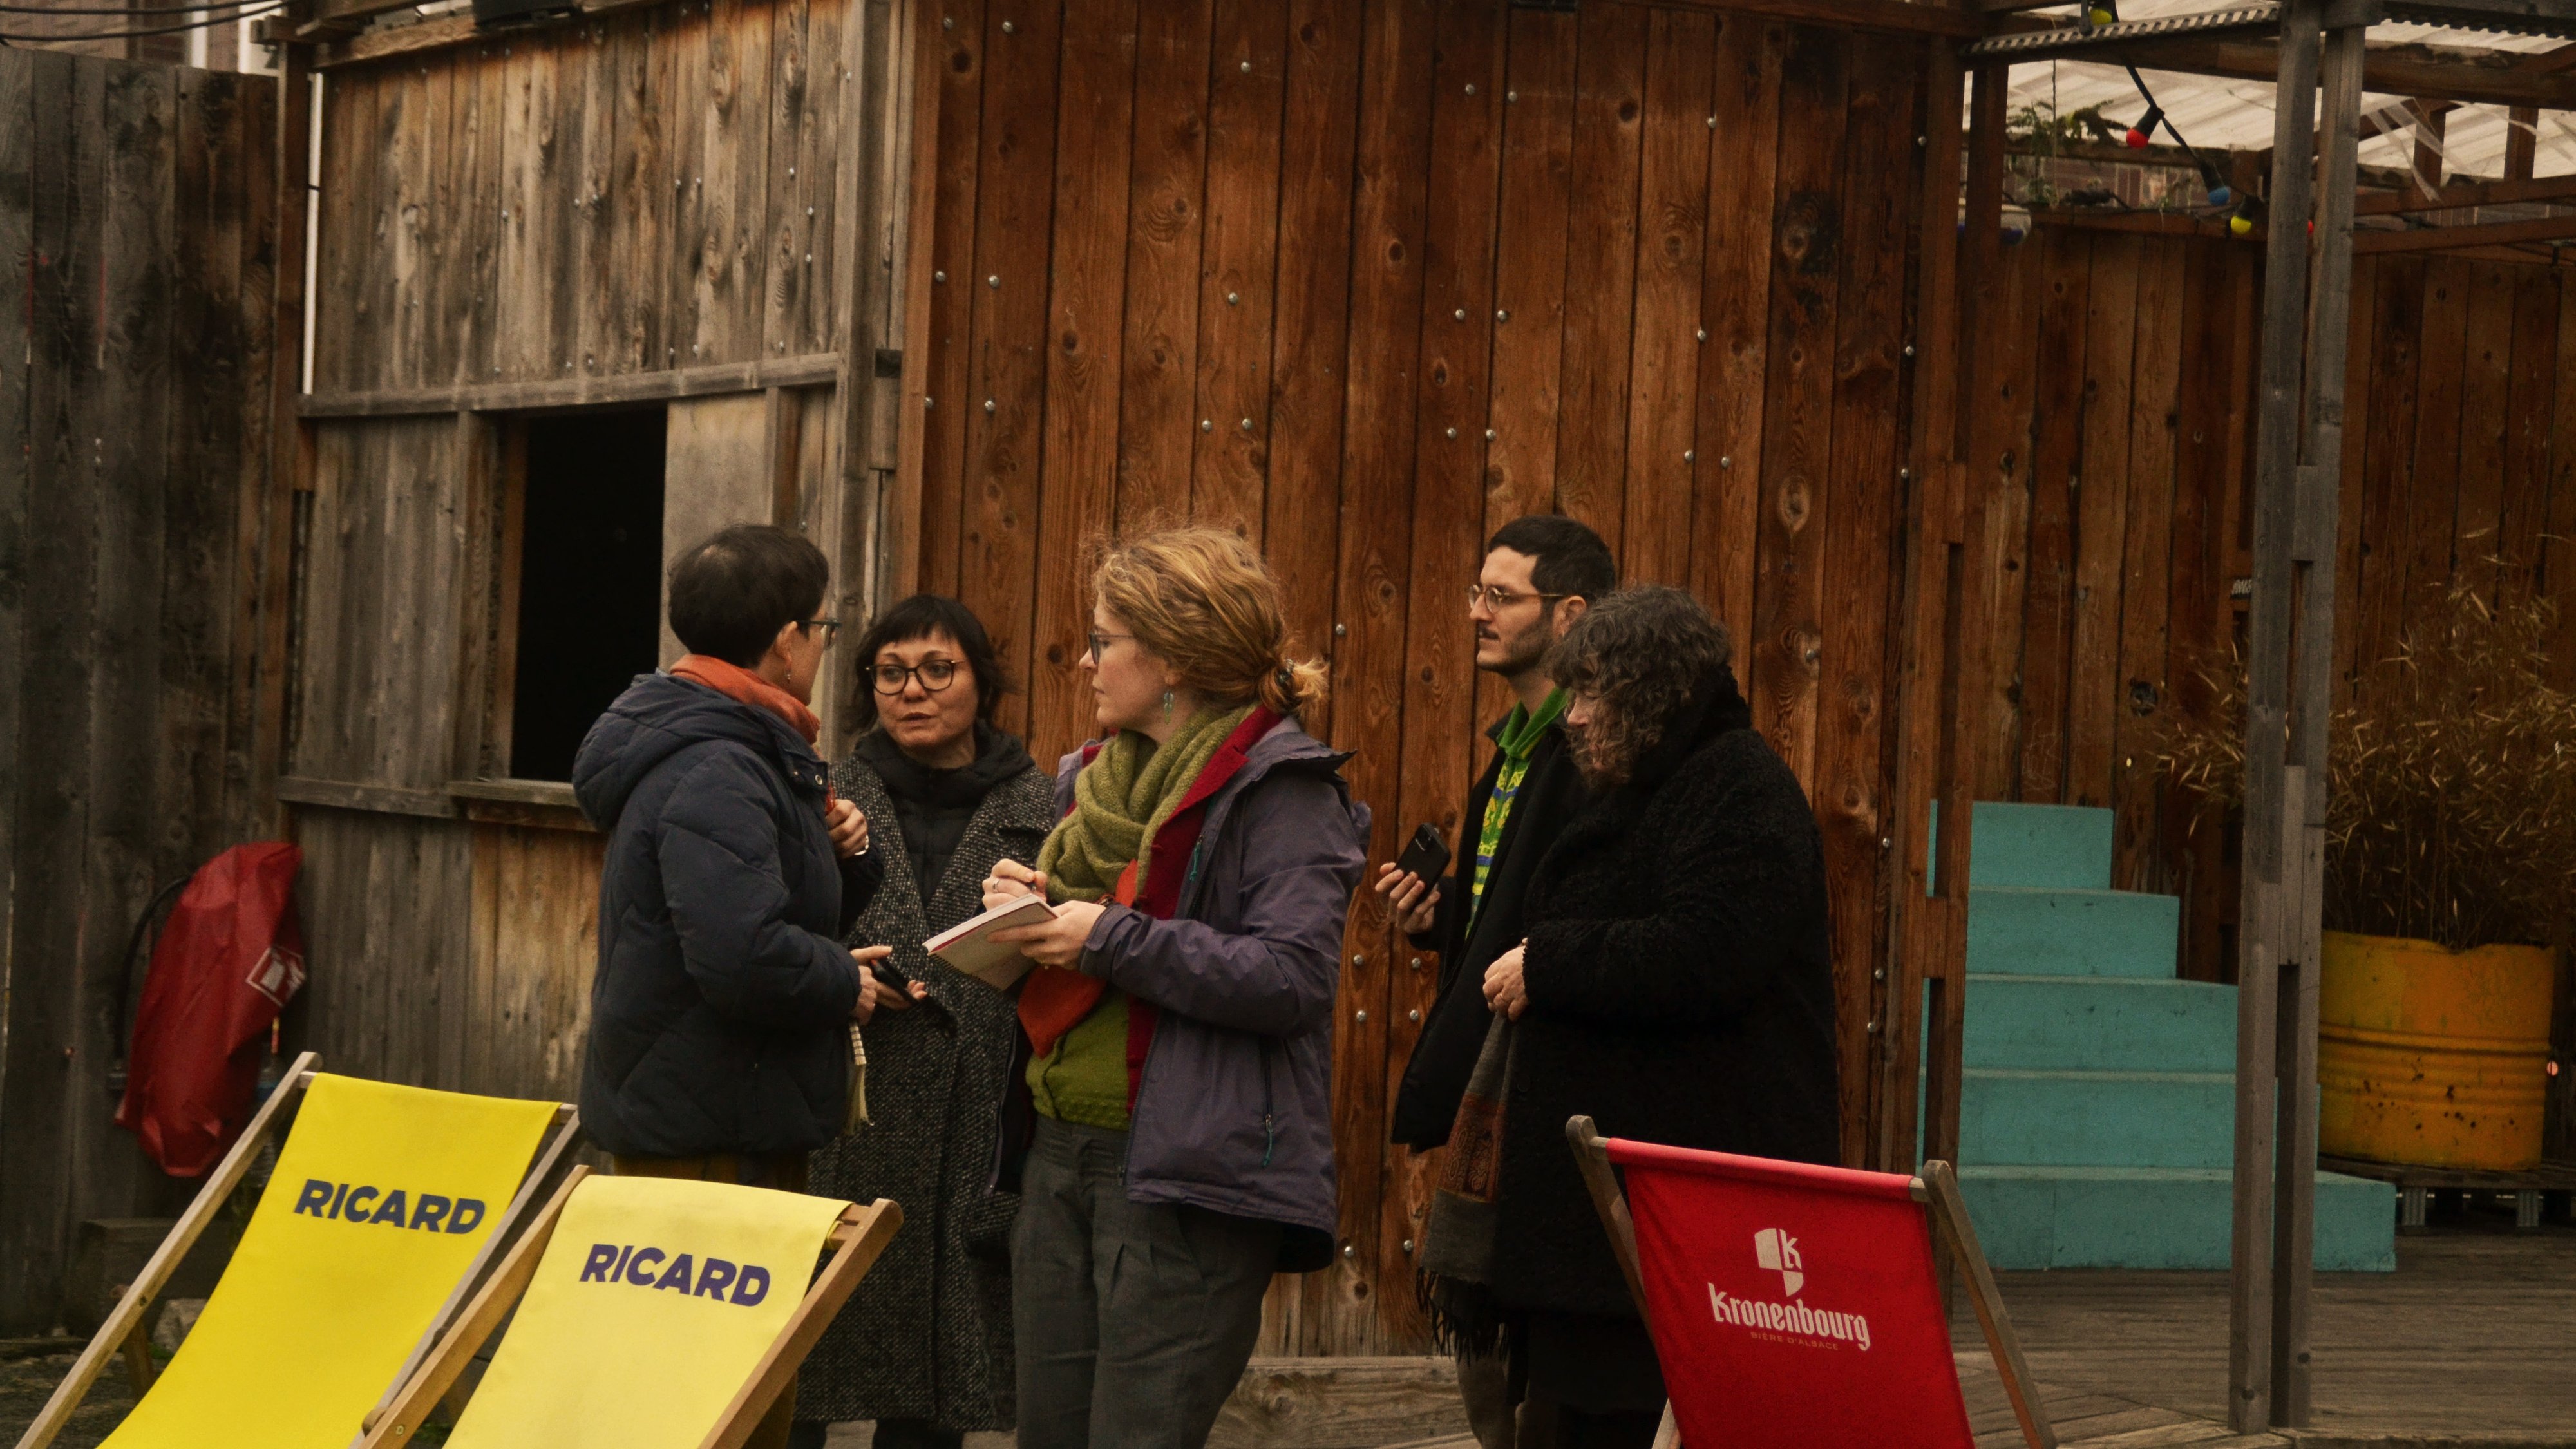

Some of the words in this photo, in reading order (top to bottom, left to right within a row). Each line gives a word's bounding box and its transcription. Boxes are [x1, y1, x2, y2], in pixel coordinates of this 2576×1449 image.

[294, 1179, 485, 1234] RICARD
[580, 1244, 770, 1307] RICARD
[1750, 1331, 1783, 1342] BIÈRE
[1787, 1336, 1839, 1350] D'ALSACE
